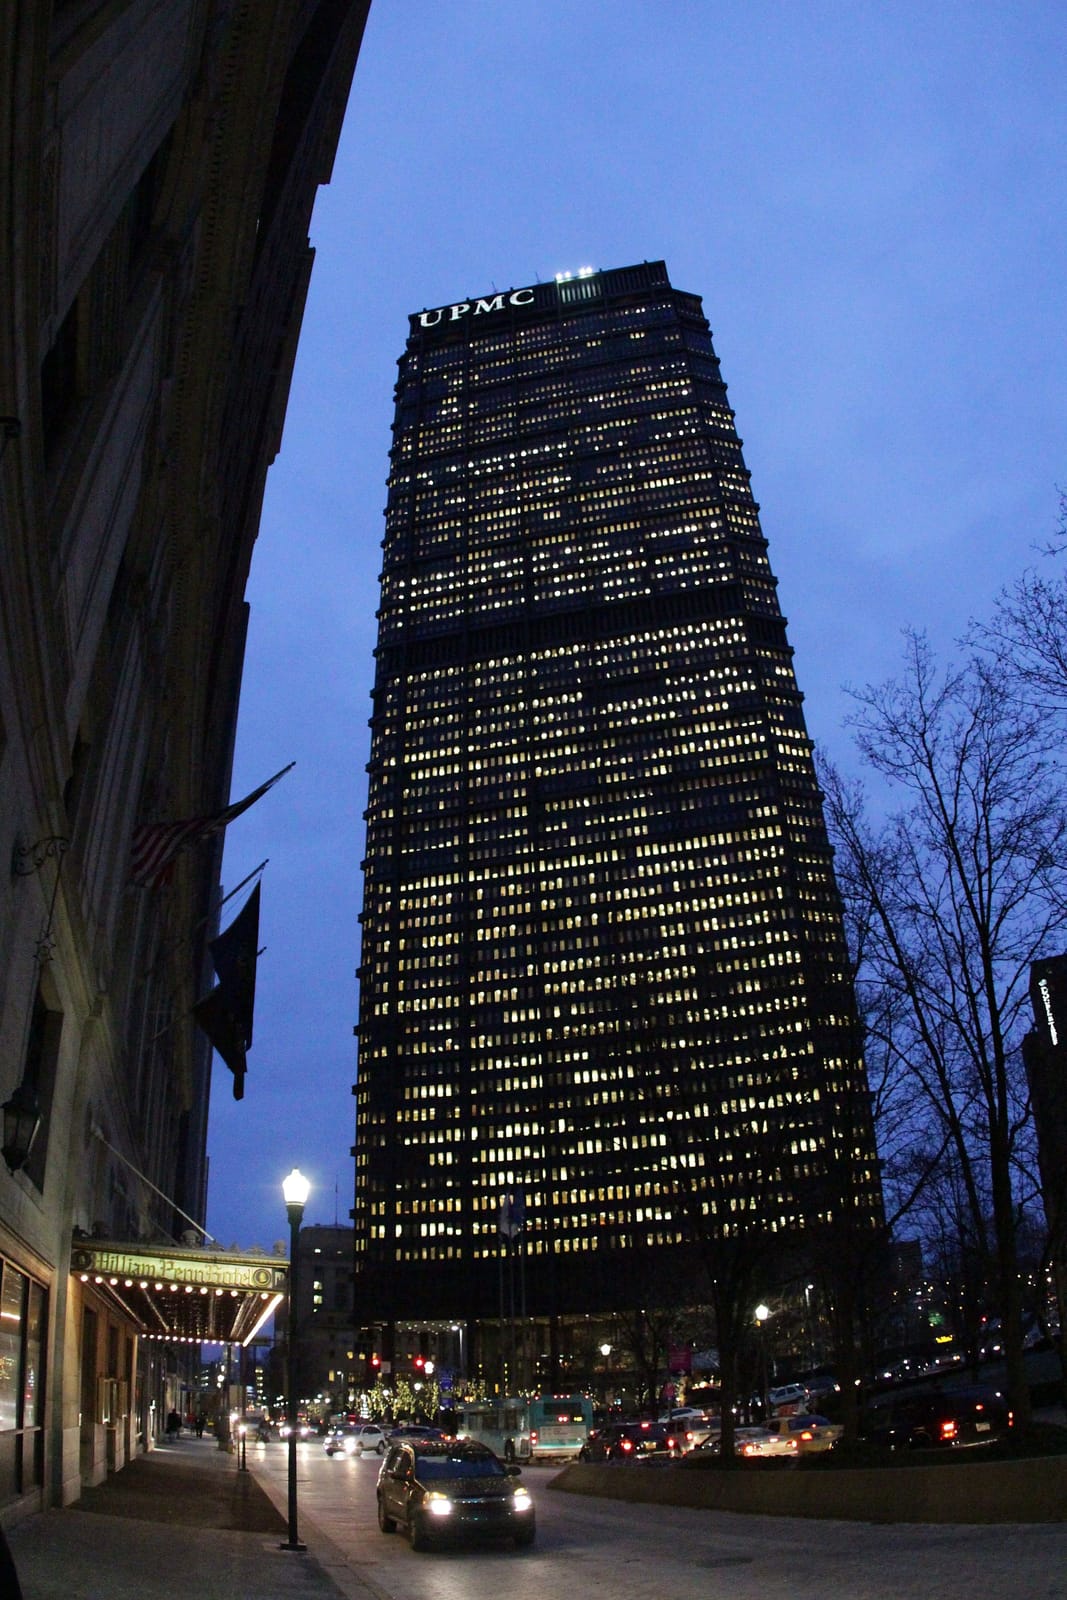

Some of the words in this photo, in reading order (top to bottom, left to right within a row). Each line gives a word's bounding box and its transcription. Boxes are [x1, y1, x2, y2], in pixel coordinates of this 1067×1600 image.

[418, 289, 535, 327] UPMC
[96, 1252, 156, 1277] William
[159, 1259, 204, 1282] Penn
[204, 1264, 252, 1286] Hotel
